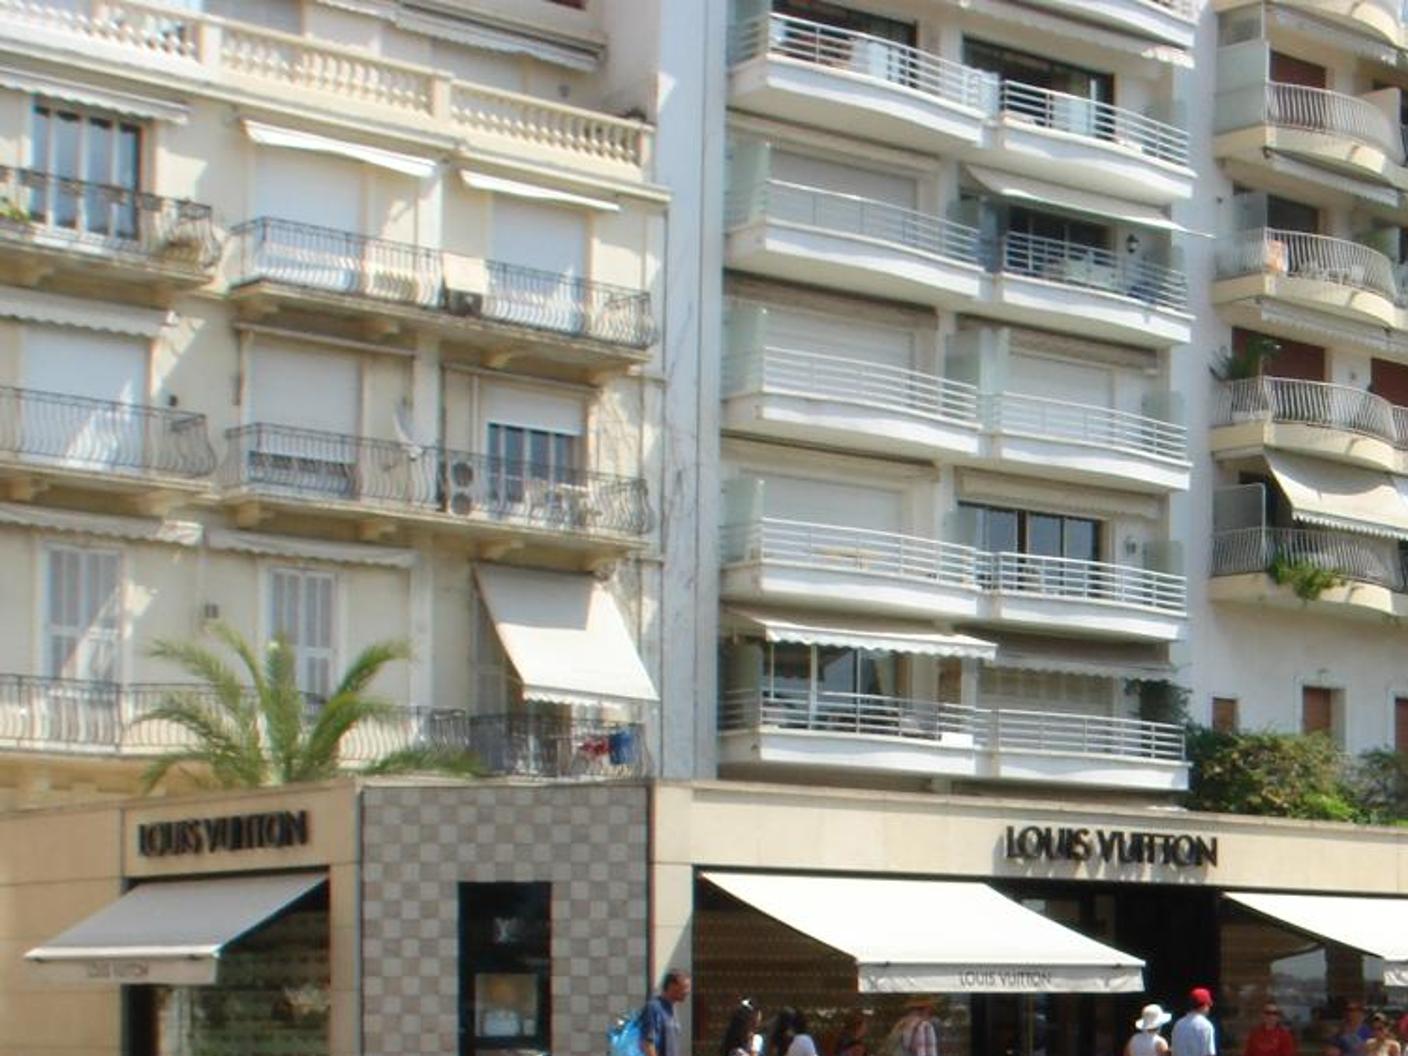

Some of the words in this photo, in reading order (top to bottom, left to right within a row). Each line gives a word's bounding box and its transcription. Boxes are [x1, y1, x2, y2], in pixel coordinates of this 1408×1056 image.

[139, 818, 200, 856] LOUIS
[202, 810, 308, 853] VUITTON
[1006, 825, 1091, 861] LOUIS
[1097, 829, 1218, 867] VUITTON
[958, 971, 995, 987] LOUIS
[1000, 971, 1051, 988] VUITTON
